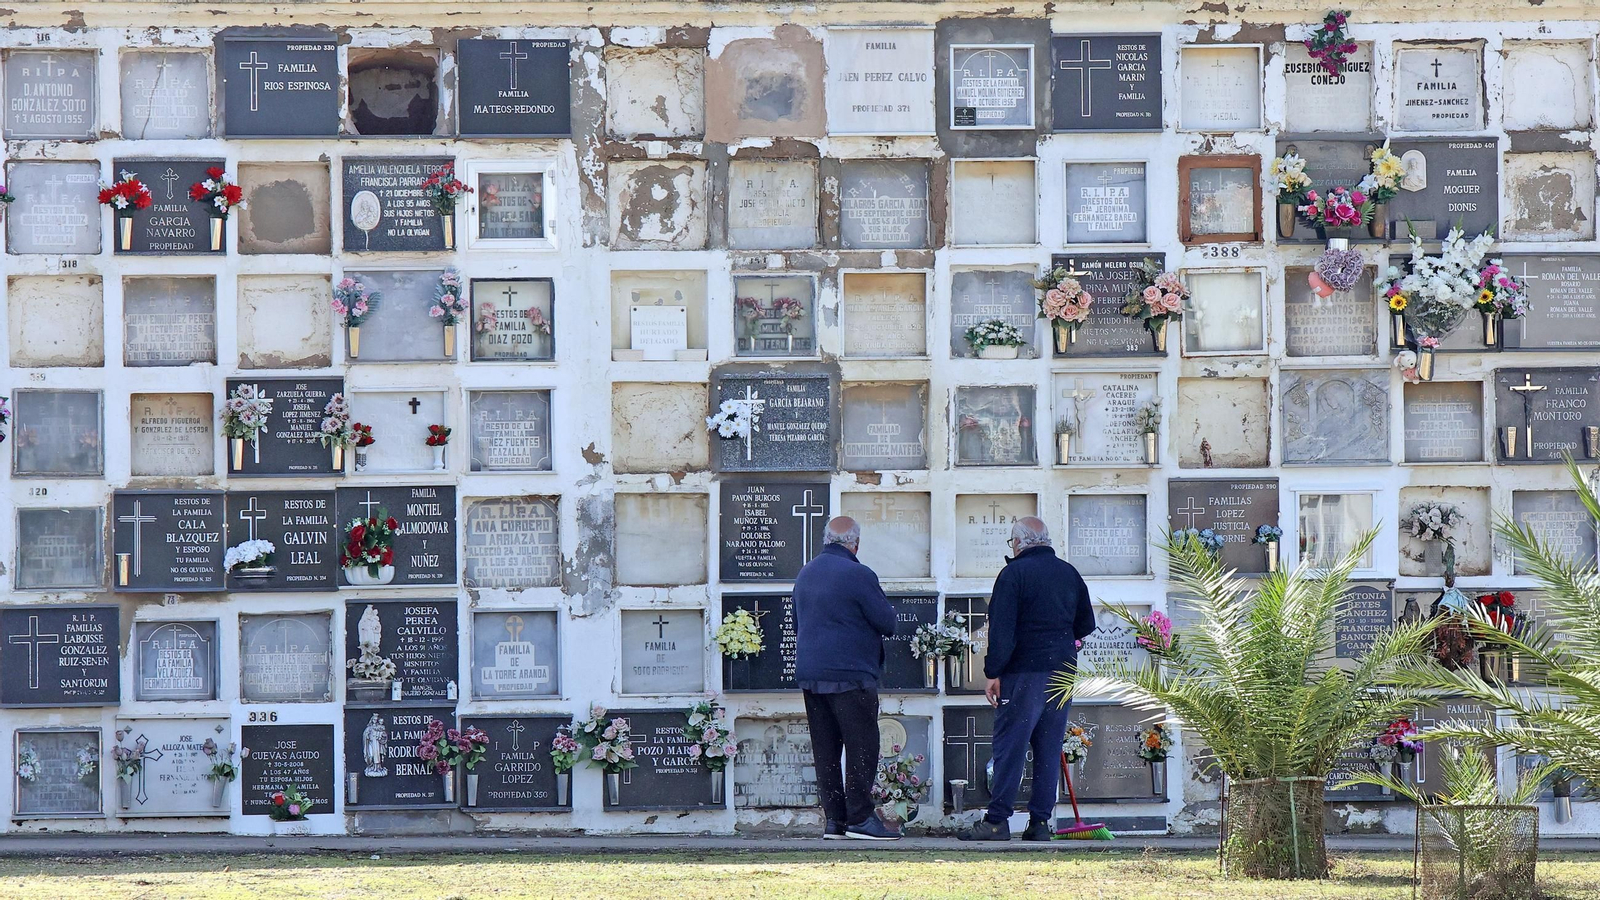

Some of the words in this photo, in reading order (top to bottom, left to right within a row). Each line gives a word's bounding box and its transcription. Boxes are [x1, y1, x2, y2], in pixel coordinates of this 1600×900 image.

[866, 42, 897, 50] FAMILIA
[1116, 53, 1148, 61] NICOLAS
[278, 64, 317, 73] FAMILIA
[1117, 63, 1146, 71] GARCIA
[1311, 75, 1346, 85] CONEJO
[264, 81, 284, 91] RIOS
[287, 81, 331, 91] ESPINOSA
[1417, 82, 1457, 90] FAMILIA
[498, 90, 529, 98] FAMILIA
[11, 99, 59, 112] GONZALEZ
[62, 98, 87, 112] SOTO
[1405, 99, 1469, 107] JIMENEZ-SANCHEZ
[473, 105, 555, 114] MATEOS-REDONDO
[1113, 167, 1144, 175] PROPIEDAD
[1443, 186, 1480, 194] MOGUER
[1448, 203, 1477, 212] DIONIS
[150, 217, 191, 226] GARCIA
[1073, 214, 1113, 222] FERNANDEZ
[1114, 214, 1137, 222] BAREA
[147, 229, 195, 237] NAVARRO
[1211, 246, 1239, 257] 388
[1541, 273, 1565, 281] ROMAN
[1567, 273, 1579, 281] DEL
[1581, 273, 1600, 281] VALLE
[494, 322, 526, 331] FAMILIA
[488, 334, 507, 344] DIAZ
[511, 334, 532, 344] POZO
[1555, 387, 1588, 395] FAMILIA
[769, 396, 792, 408] GARCÍA
[793, 398, 824, 407] BEJARANO
[1545, 399, 1586, 408] FRANCO
[1533, 411, 1582, 420] MONTORO
[511, 422, 522, 430] DE
[523, 422, 533, 430] LA
[505, 437, 539, 447] FUENTES
[411, 489, 436, 498] FAMILIA
[747, 486, 765, 494] JUAN
[284, 500, 314, 509] RESTOS
[315, 500, 326, 509] DE
[1209, 497, 1252, 505] FAMILIAS
[407, 504, 442, 516] MONTIEL
[1216, 510, 1245, 518] LOPEZ
[178, 520, 206, 529] CALA
[282, 516, 293, 525] LA
[295, 516, 328, 524] FAMILIA
[733, 516, 758, 524] MUÑOZ
[400, 522, 449, 534] ALMODOVAR
[1211, 522, 1251, 530] JUSTICIA
[166, 532, 219, 544] BLAZQUEZ
[284, 532, 328, 544] GALVIN
[423, 540, 427, 549] Y
[726, 540, 757, 548] NARANJO
[758, 540, 786, 548] PALOMO
[291, 552, 321, 564] LEAL
[411, 554, 439, 568] NUÑEZ
[403, 607, 439, 615] JOSEFA
[405, 617, 438, 625] PEREA
[66, 624, 102, 632] FAMILIAS
[397, 627, 447, 635] CALVILLO
[64, 634, 104, 643] LABOISSE
[60, 646, 108, 655] GONZALEZ
[499, 645, 531, 655] FAMILIA
[645, 642, 676, 651] FAMILIA
[159, 651, 182, 659] RESTOS
[656, 654, 665, 663] DE
[59, 657, 109, 666] RUIZ-SENEN
[158, 659, 166, 667] LA
[168, 659, 193, 667] FAMILIA
[510, 658, 519, 666] DE
[81, 668, 87, 677] Y
[158, 668, 193, 678] VELAZQUEZ
[483, 670, 493, 680] LA
[495, 669, 517, 679] TORRE
[518, 669, 547, 678] ARANDA
[60, 678, 108, 688] SANTORUM
[1447, 705, 1482, 714] FAMILIA
[249, 711, 278, 722] 336
[393, 716, 421, 725] RESTOS
[423, 715, 434, 724] DE
[655, 727, 685, 735] RESTOS
[179, 735, 193, 743] JOSE
[275, 741, 297, 750] JOSE
[252, 751, 288, 760] CUEVAS
[289, 751, 320, 760] AGUDO
[637, 747, 664, 756] POZO
[395, 763, 433, 776] BERNAL
[494, 763, 541, 772] GARRIDO
[502, 775, 534, 784] LOPEZ
